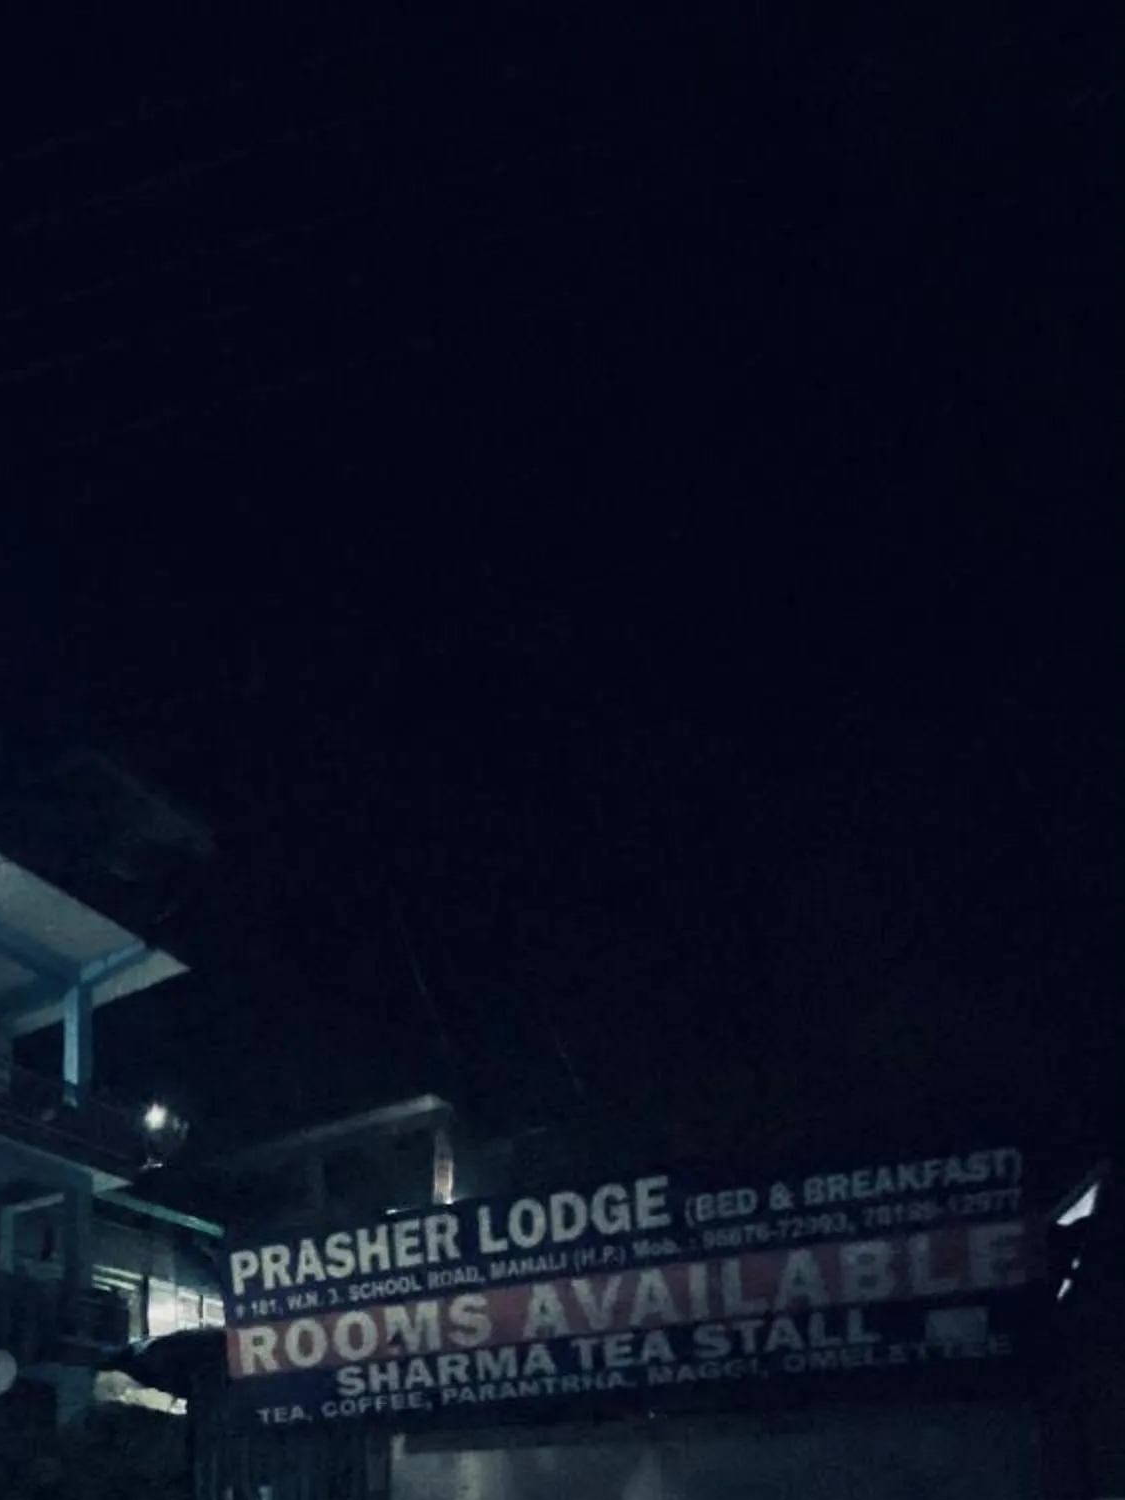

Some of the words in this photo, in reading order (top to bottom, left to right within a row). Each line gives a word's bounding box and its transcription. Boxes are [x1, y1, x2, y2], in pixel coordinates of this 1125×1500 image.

[229, 1212, 463, 1297] PRASHER
[477, 1174, 672, 1255] LODGE
[684, 1187, 759, 1228] (BED
[768, 1181, 795, 1212] &
[802, 1146, 1024, 1207] BREAKFAST)
[236, 1292, 494, 1376] ROOMS
[522, 1221, 1027, 1340] AVAILABLE
[348, 1275, 422, 1304] SCHOOL
[336, 1342, 557, 1398] SHARMA
[572, 1327, 676, 1370] TEA
[693, 1307, 883, 1359] STALL
[319, 1388, 434, 1420] COFFEE,
